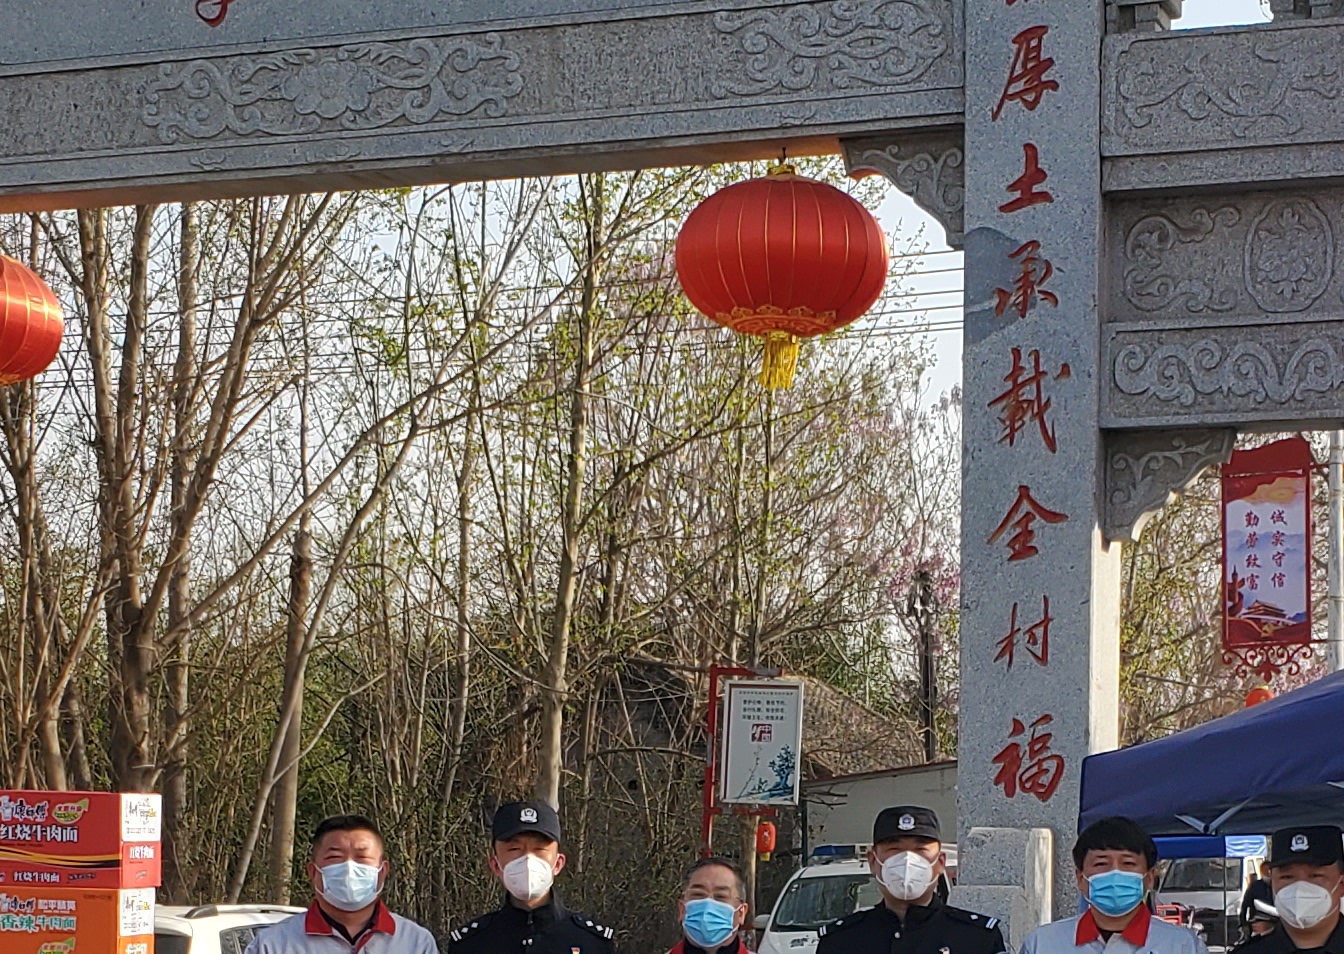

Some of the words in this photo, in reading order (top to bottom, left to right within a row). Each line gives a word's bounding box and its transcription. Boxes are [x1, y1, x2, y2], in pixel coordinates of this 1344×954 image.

[1244, 510, 1262, 591] 勤劳致富
[1270, 509, 1288, 589] 诚实守信
[0, 824, 78, 842] 红烧牛肉面
